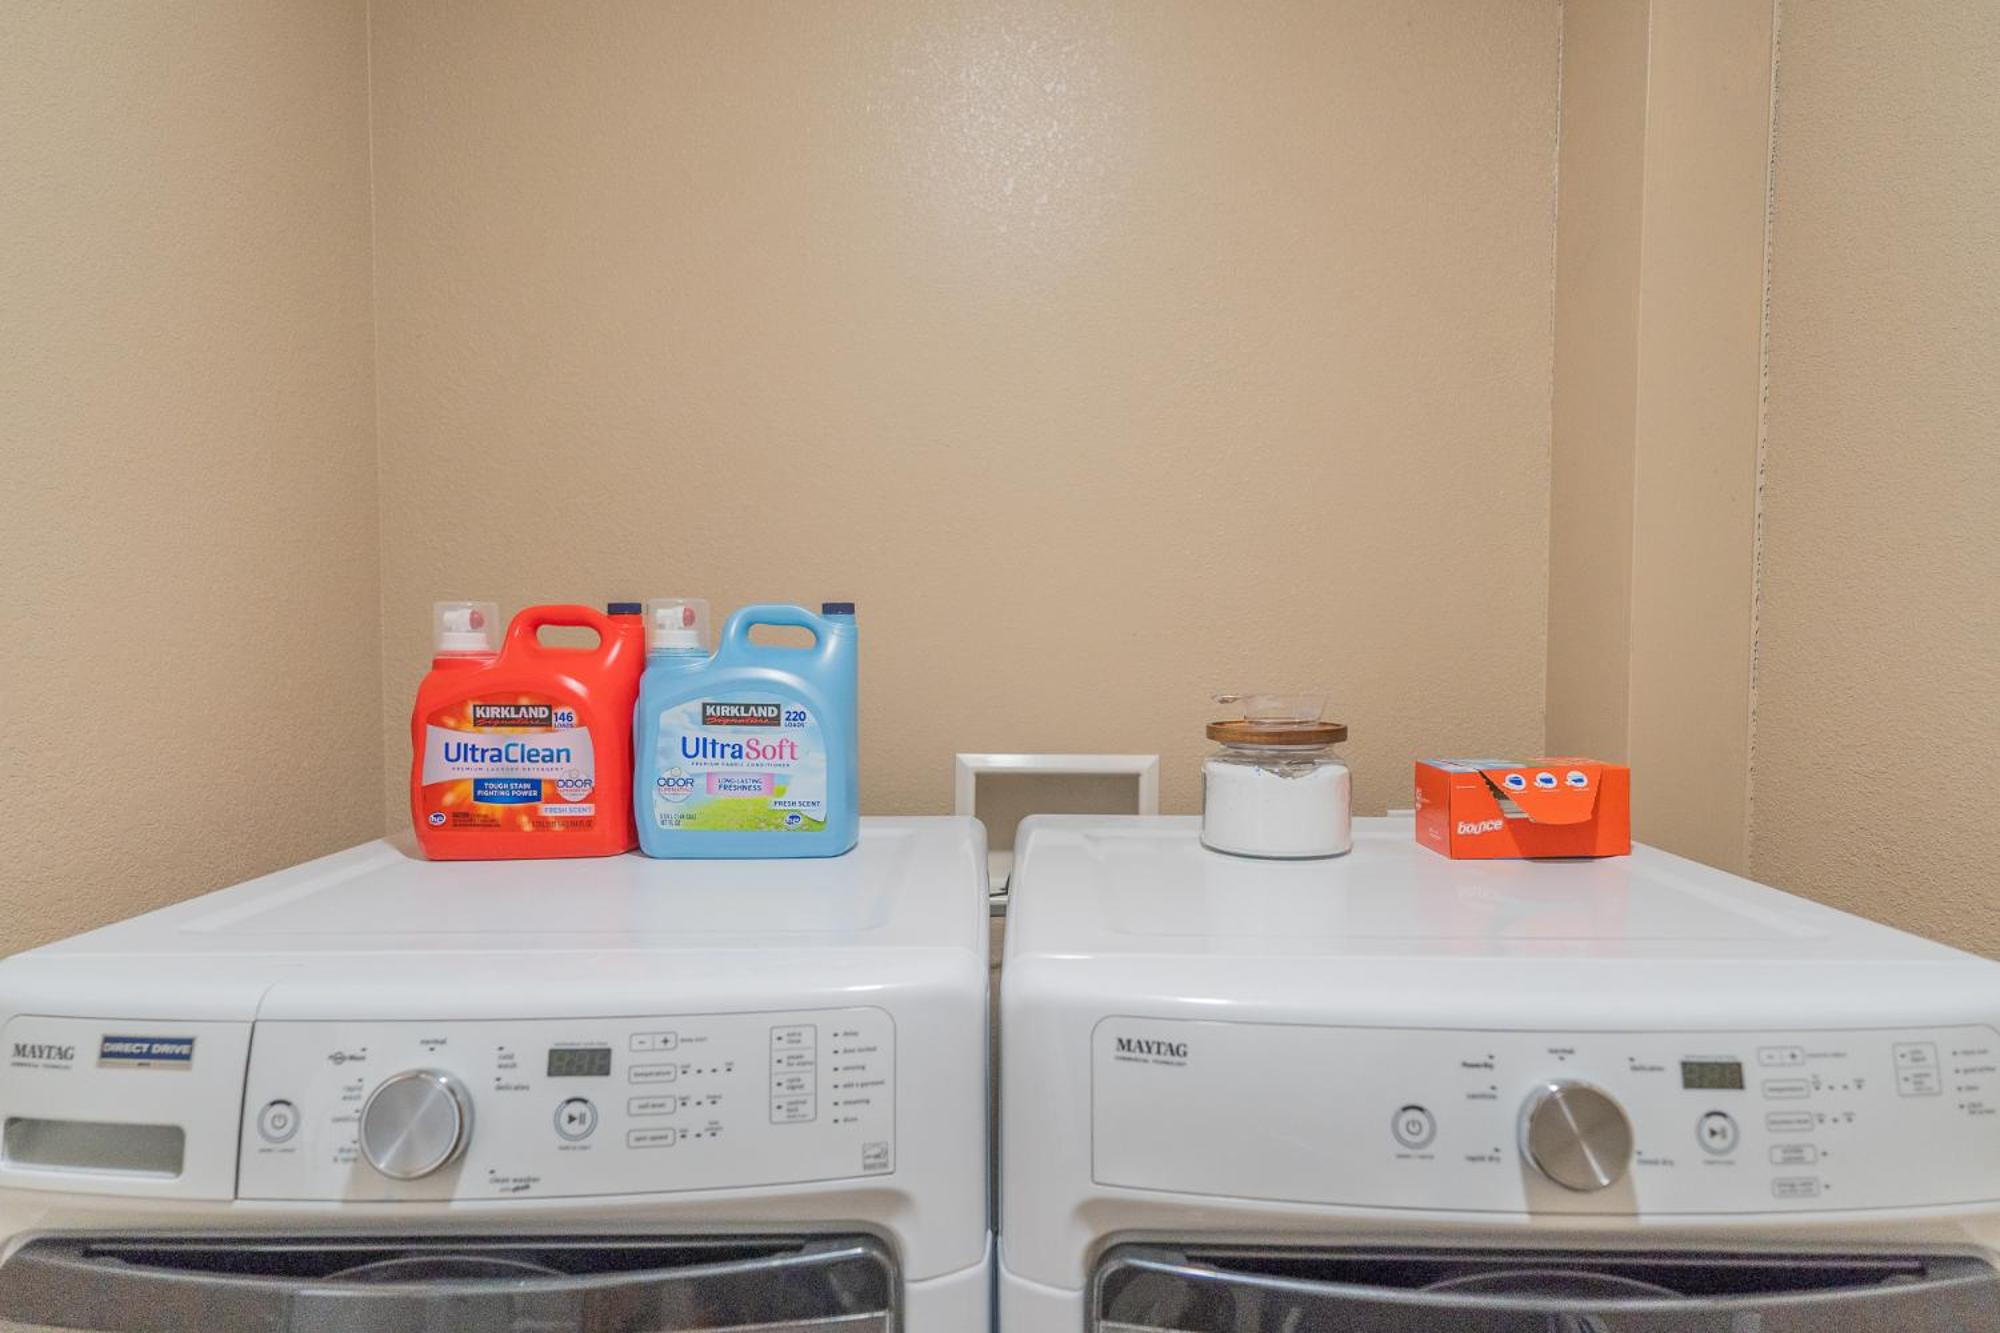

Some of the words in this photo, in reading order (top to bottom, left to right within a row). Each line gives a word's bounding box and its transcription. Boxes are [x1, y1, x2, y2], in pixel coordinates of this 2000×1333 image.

[475, 706, 550, 718] KIRKLAND
[553, 712, 574, 722] 146
[706, 705, 778, 717] KIRKLAND
[784, 710, 807, 722] 220
[444, 741, 571, 764] UltraClean
[681, 736, 799, 761] UltraSoft
[556, 779, 593, 789] ODOR
[657, 777, 695, 787] ODOR
[1456, 818, 1504, 836] bounce
[12, 1043, 75, 1061] MAYTAG
[103, 1042, 150, 1054] DIRECT
[152, 1043, 192, 1055] DRIVE
[1115, 1037, 1188, 1058] MAYTAG
